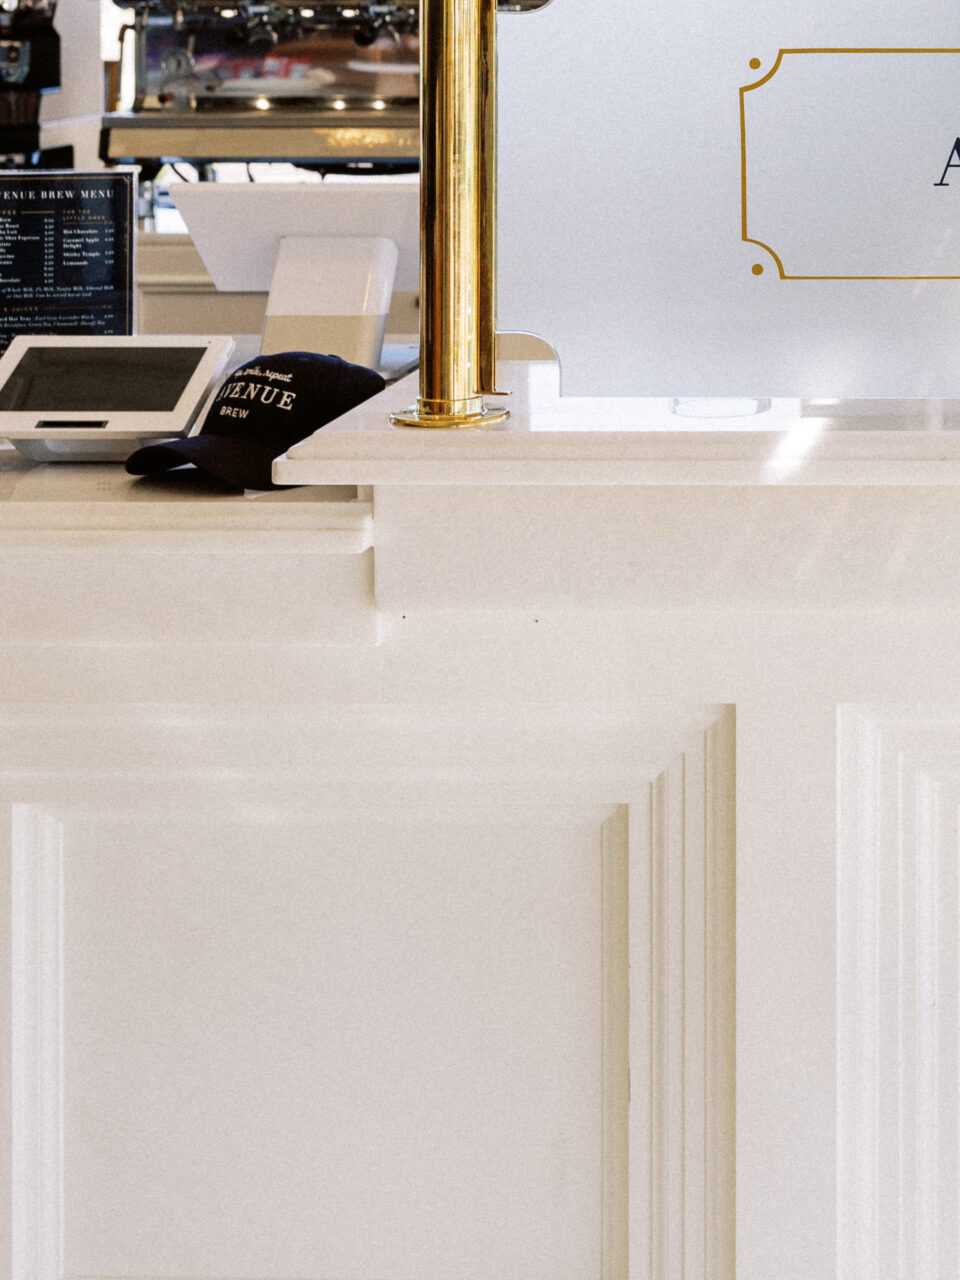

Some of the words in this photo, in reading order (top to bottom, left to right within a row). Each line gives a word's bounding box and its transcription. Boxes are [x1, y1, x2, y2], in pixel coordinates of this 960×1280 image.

[0, 191, 35, 199] ENUE
[81, 190, 114, 198] MENU
[262, 369, 293, 382] repeat
[220, 406, 249, 418] BREW
